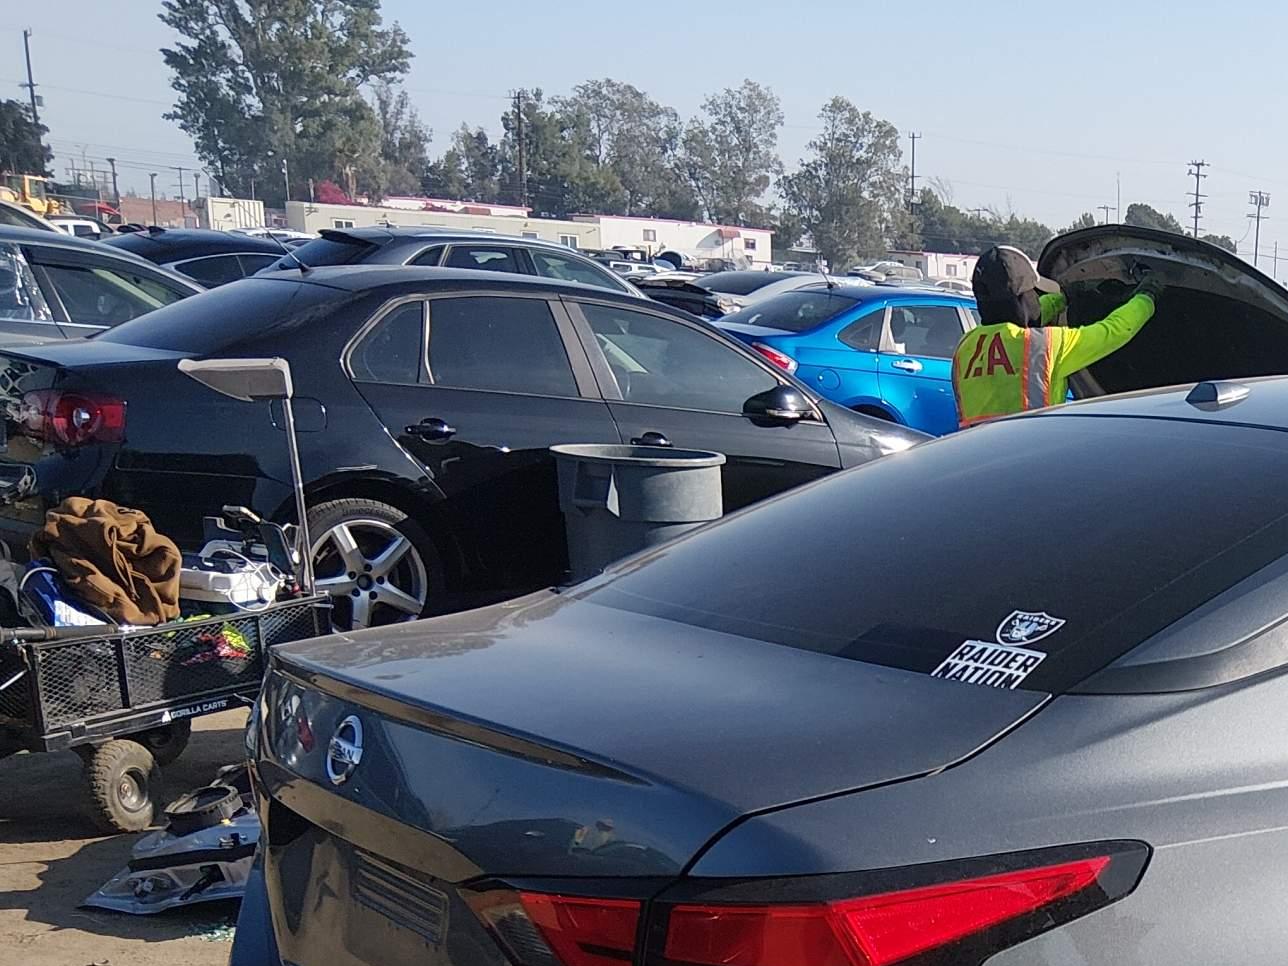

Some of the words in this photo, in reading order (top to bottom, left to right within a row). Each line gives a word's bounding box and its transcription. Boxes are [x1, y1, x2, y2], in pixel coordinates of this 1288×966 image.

[949, 644, 1041, 674] RAIDER
[937, 661, 1023, 689] NATION
[171, 706, 202, 719] GORILLA
[202, 701, 227, 712] CARTS
